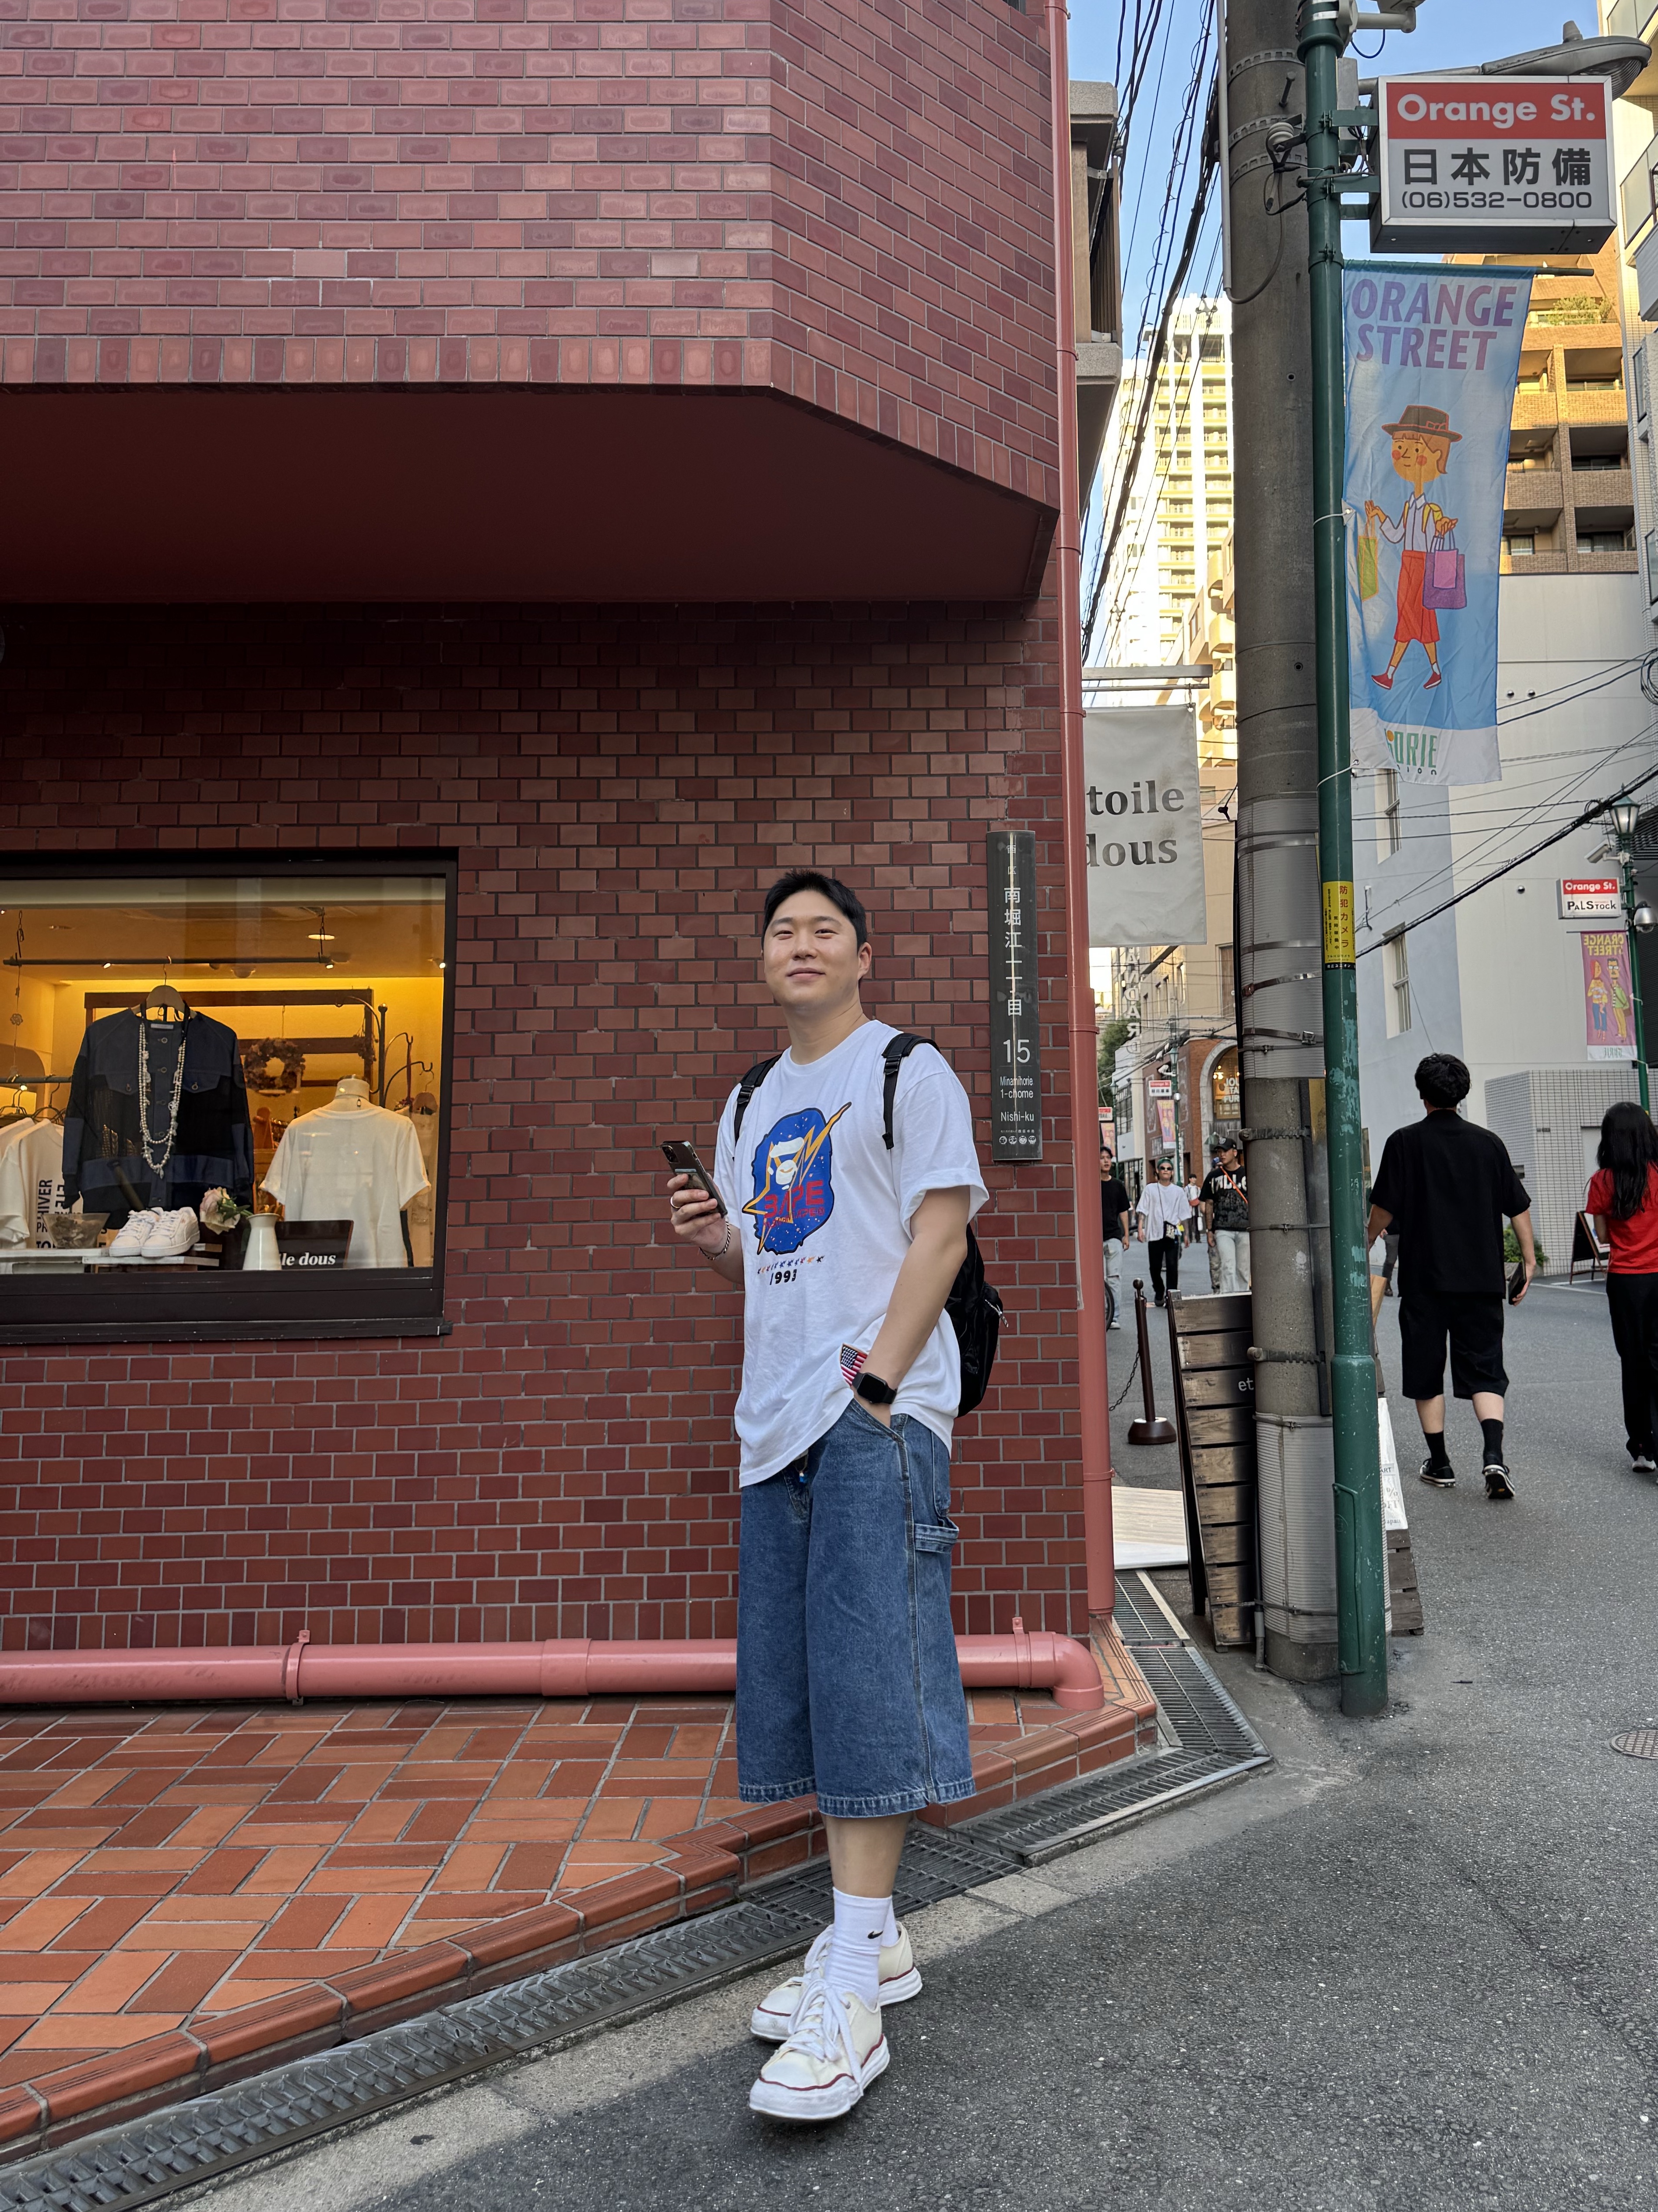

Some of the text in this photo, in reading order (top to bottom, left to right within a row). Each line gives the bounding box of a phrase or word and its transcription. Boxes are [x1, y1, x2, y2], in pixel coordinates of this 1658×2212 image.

[1398, 94, 1595, 129] Orange St.
[1404, 147, 1591, 186] 日本防備
[1402, 191, 1592, 209] (06)532-0800
[1352, 279, 1517, 327] ORANGE
[1356, 324, 1498, 370] STREET
[1086, 780, 1184, 815] toile
[1565, 882, 1601, 892] Orange
[1339, 886, 1348, 948] 防犯カメラ
[1003, 1039, 1030, 1063] 15
[1000, 1076, 1033, 1086] Minamihorie
[1000, 1088, 1034, 1098] 1-chome
[1001, 1111, 1034, 1122] Nishi-ku
[298, 1252, 336, 1266] dous
